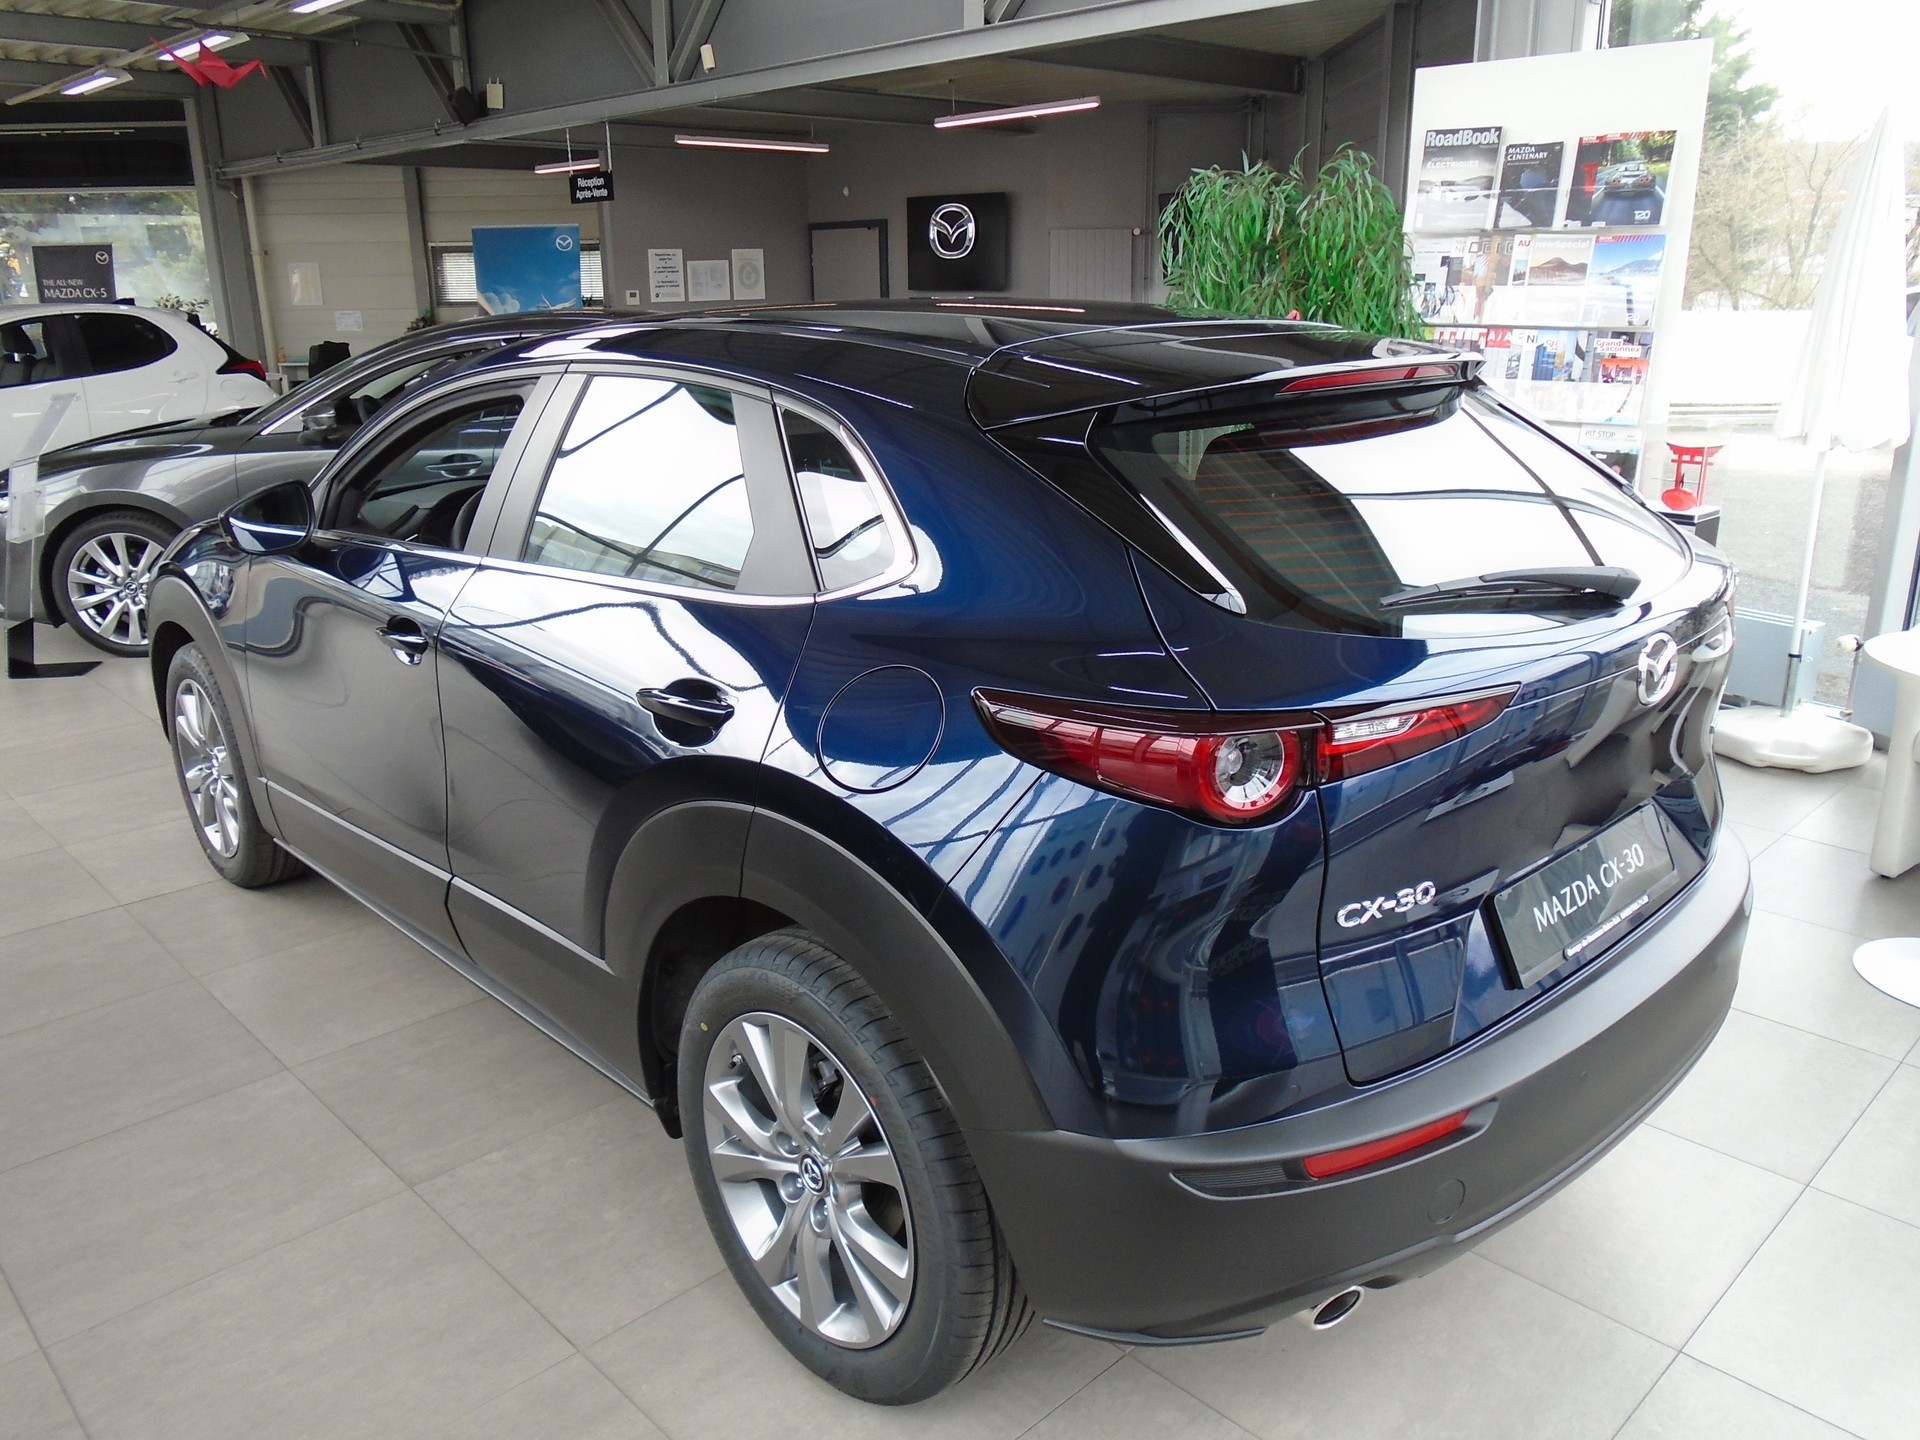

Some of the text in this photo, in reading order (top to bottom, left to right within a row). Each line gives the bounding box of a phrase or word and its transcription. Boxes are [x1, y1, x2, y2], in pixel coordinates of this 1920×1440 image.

[1425, 128, 1500, 147] RoadBook
[1508, 146, 1536, 154] MAZDA
[1507, 151, 1549, 161] CENTENARY
[577, 176, 605, 188] Réception
[575, 188, 608, 201] Après-Vente
[44, 287, 108, 298] MAZDA CX-5
[1595, 339, 1622, 348] Grand
[1585, 429, 1596, 437] PIT
[1597, 430, 1616, 438] STOP
[1533, 876, 1600, 932] MAZDA
[1600, 843, 1645, 889] CX-30
[1336, 881, 1436, 928] CX-30
